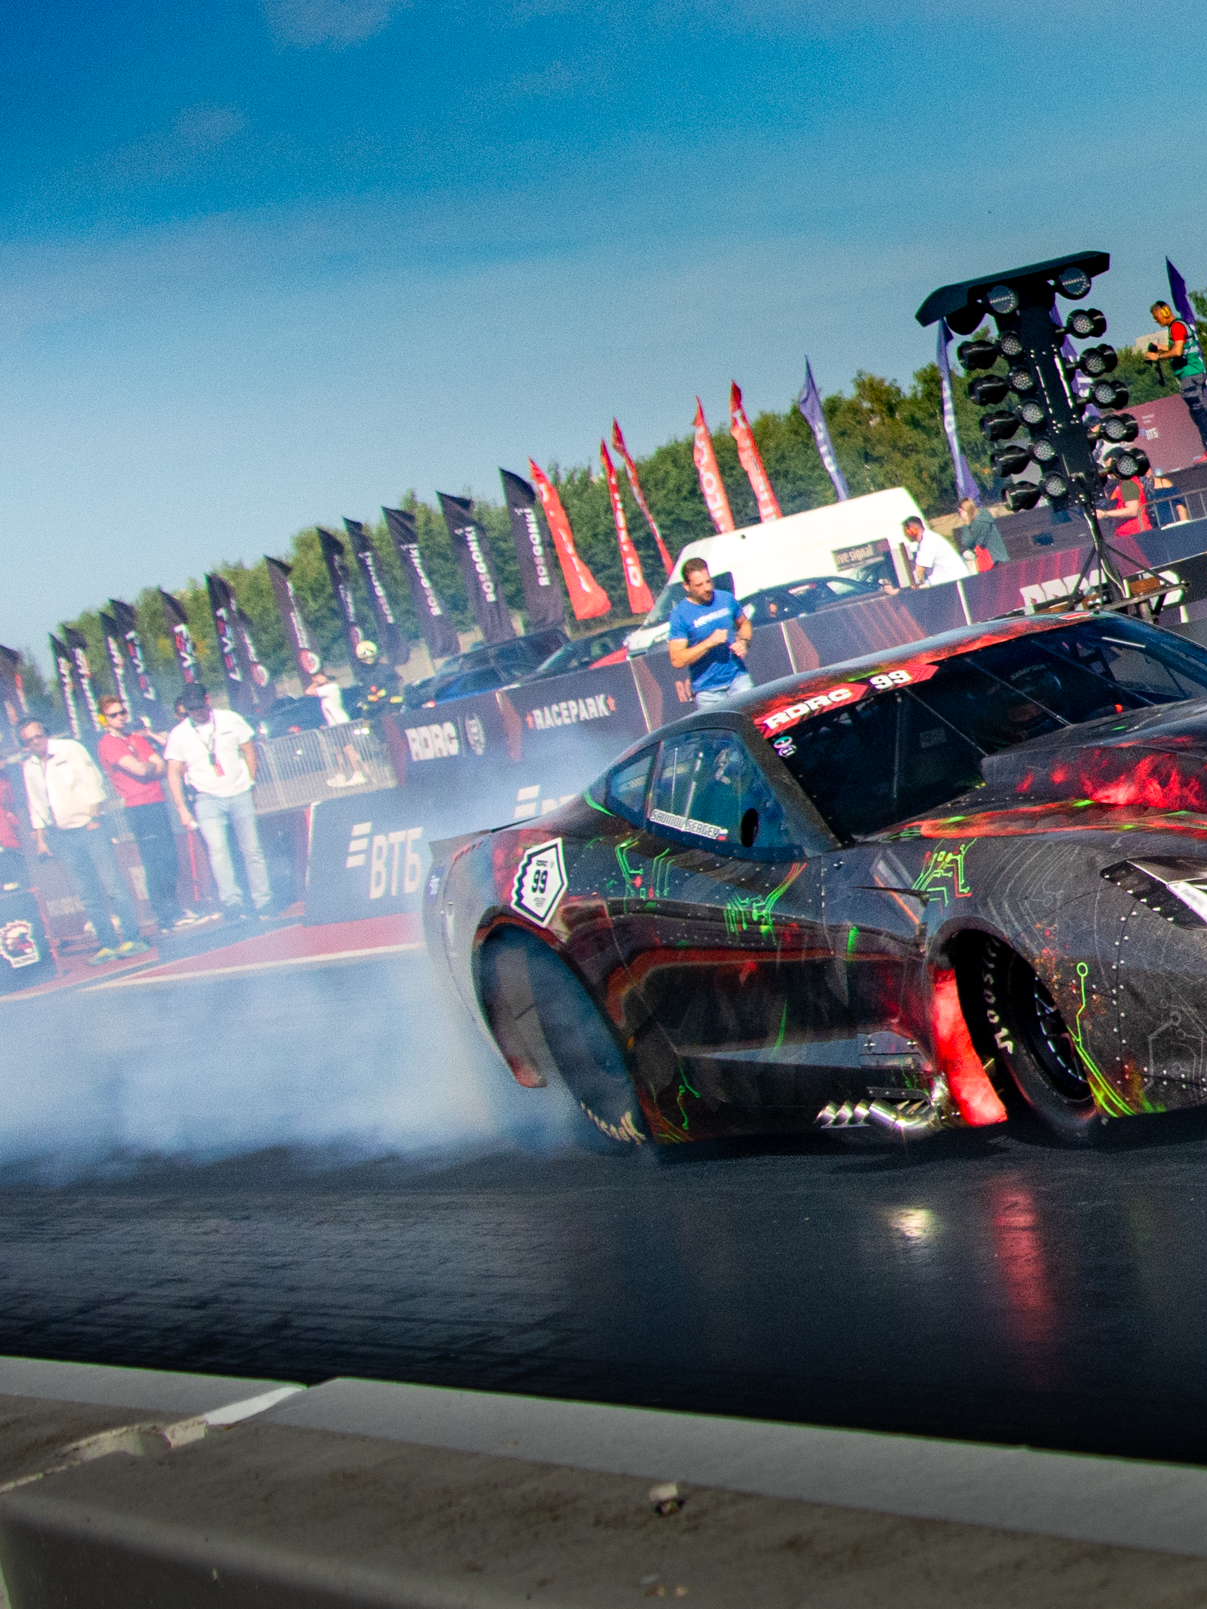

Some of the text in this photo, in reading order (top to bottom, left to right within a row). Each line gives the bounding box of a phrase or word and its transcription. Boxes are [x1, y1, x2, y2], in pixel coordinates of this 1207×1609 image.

[532, 693, 610, 730] RACEPARK
[763, 669, 912, 730] RDRC 99
[404, 721, 459, 762] RDRC
[686, 819, 720, 839] SERGEY
[369, 826, 423, 900] ВТБ
[531, 869, 548, 893] 99
